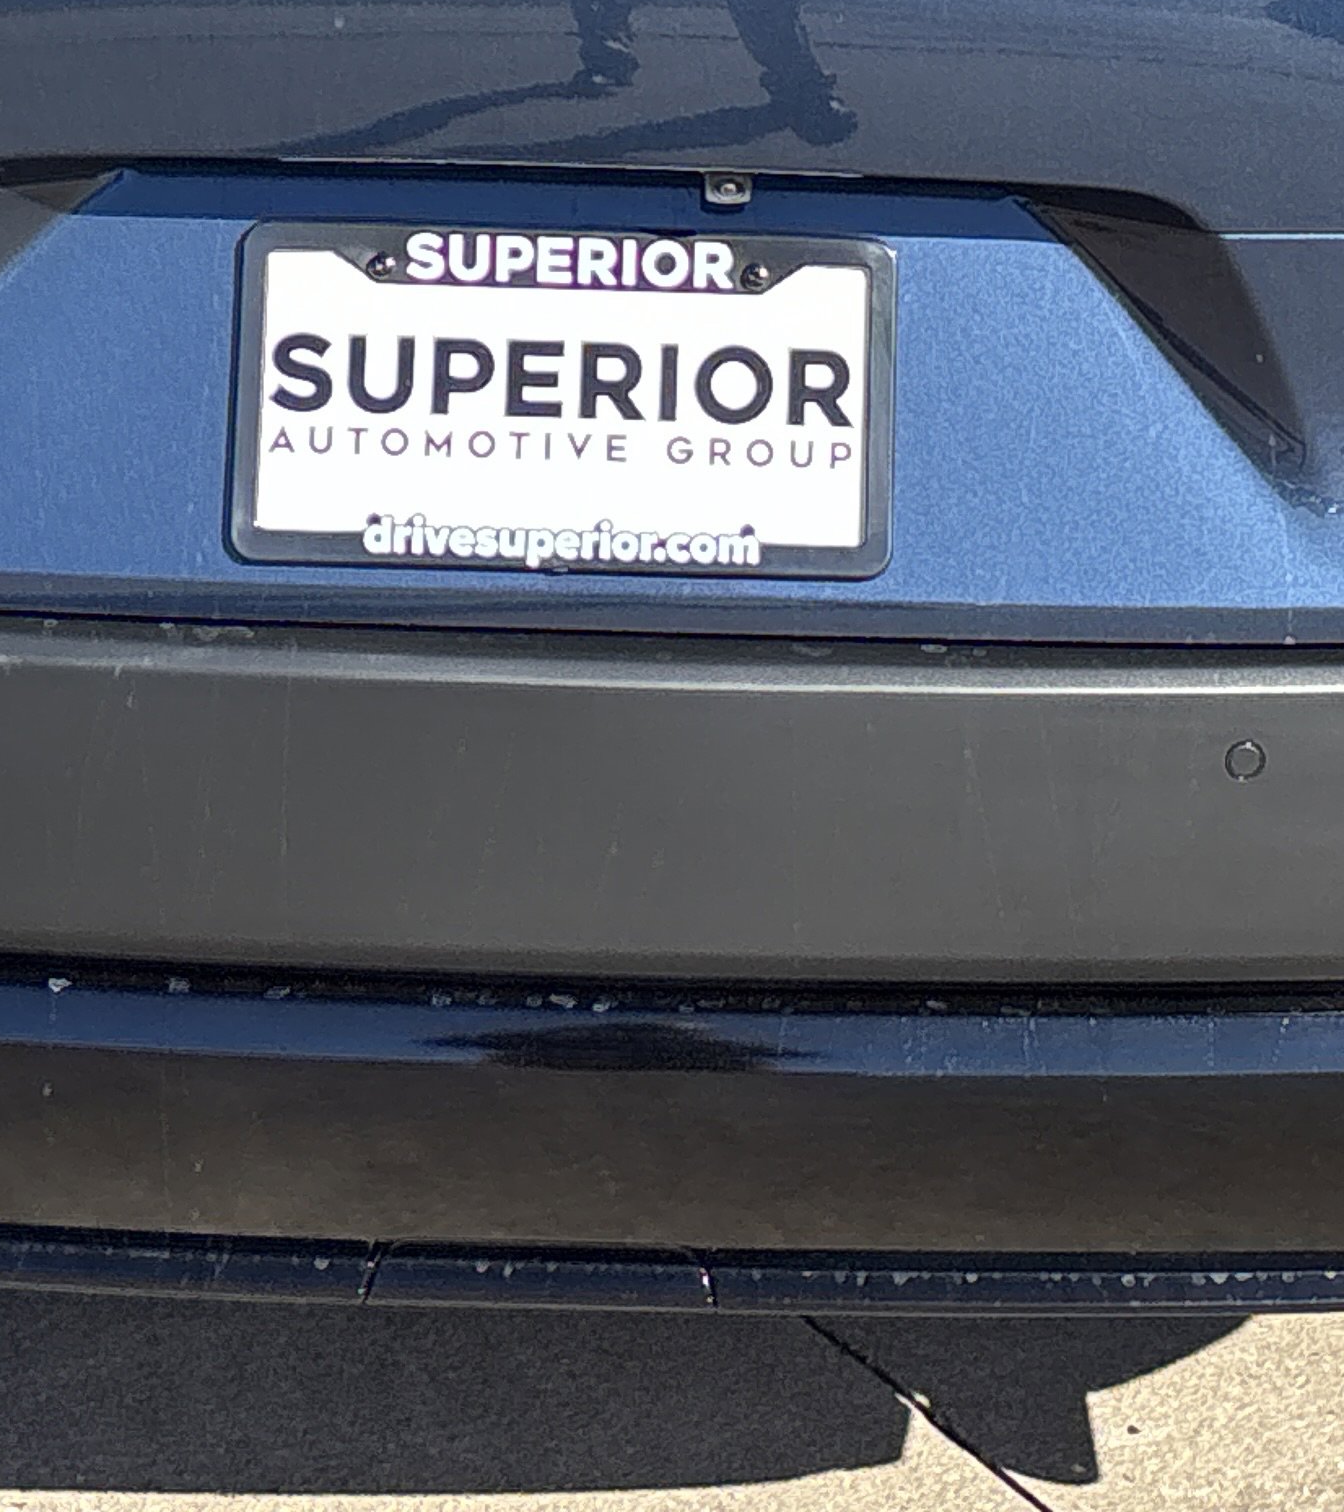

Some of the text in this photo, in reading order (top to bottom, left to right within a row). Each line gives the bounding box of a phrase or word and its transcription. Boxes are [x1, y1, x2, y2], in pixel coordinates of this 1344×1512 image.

[405, 231, 734, 289] SUPERIOR
[269, 332, 854, 428] SUPERIOR
[268, 426, 853, 468] AUTOMOTIVE GROUP
[363, 513, 761, 568] drivesuperior.com
